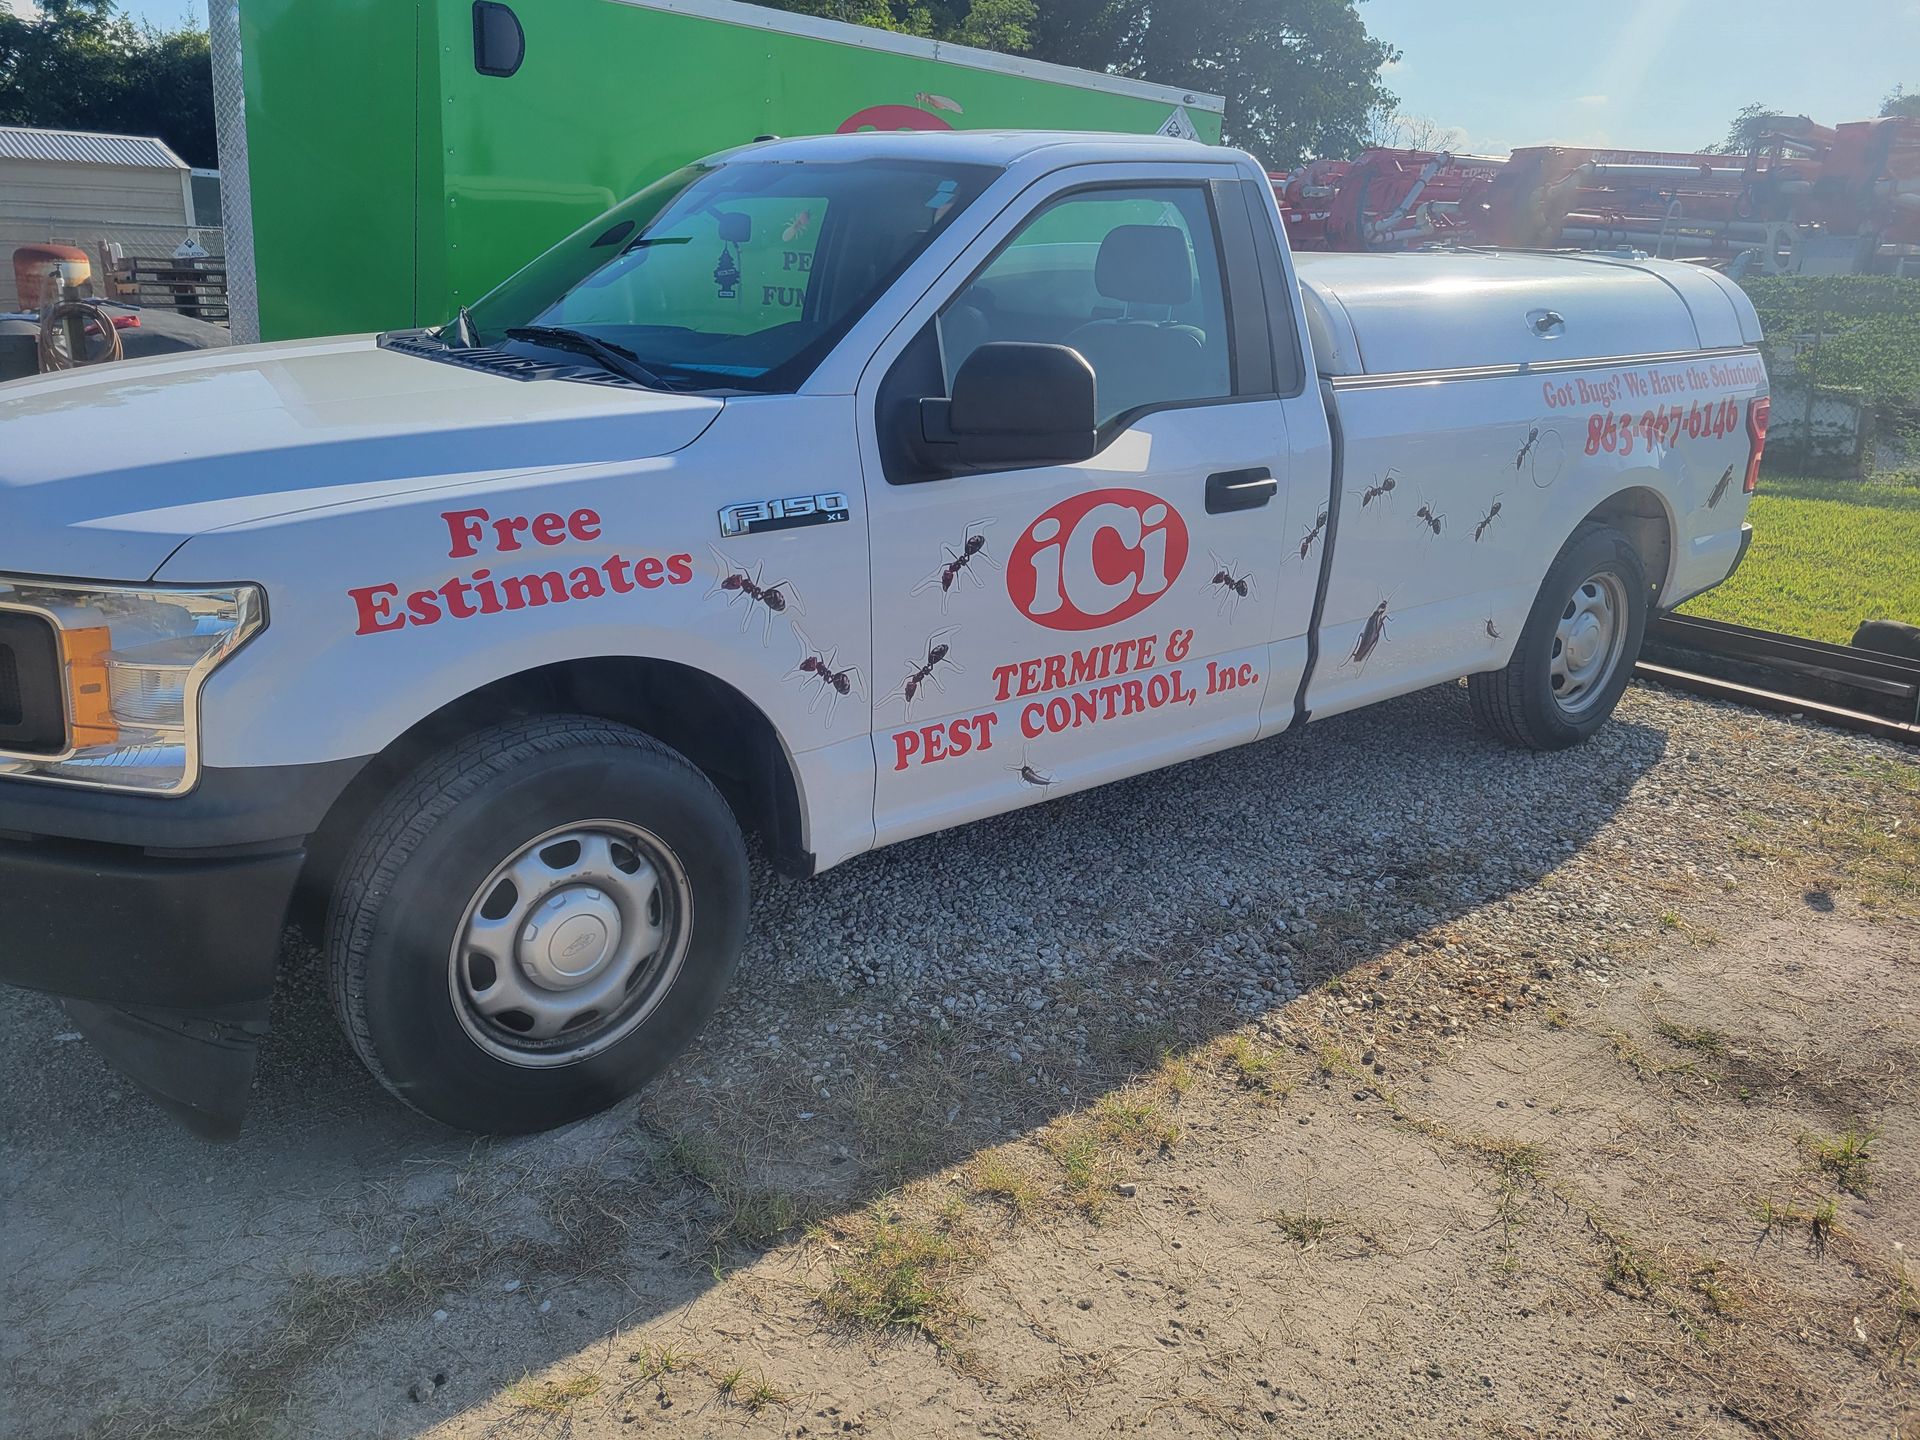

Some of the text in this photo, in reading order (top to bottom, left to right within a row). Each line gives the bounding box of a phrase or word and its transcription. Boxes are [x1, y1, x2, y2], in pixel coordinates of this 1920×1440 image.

[782, 251, 813, 272] PE
[1542, 381, 1576, 409] Got
[1575, 373, 1621, 408] Bugs?
[1622, 371, 1649, 398] We
[1647, 370, 1685, 396] Have
[1686, 366, 1710, 391] the
[1584, 395, 1739, 457] 863-967-6146
[441, 508, 602, 559] Free
[826, 513, 845, 521] XL
[348, 553, 694, 636] Estimates
[991, 629, 1194, 702] TERMITE &
[892, 661, 1260, 771] PEST CONTROL, Inc.
